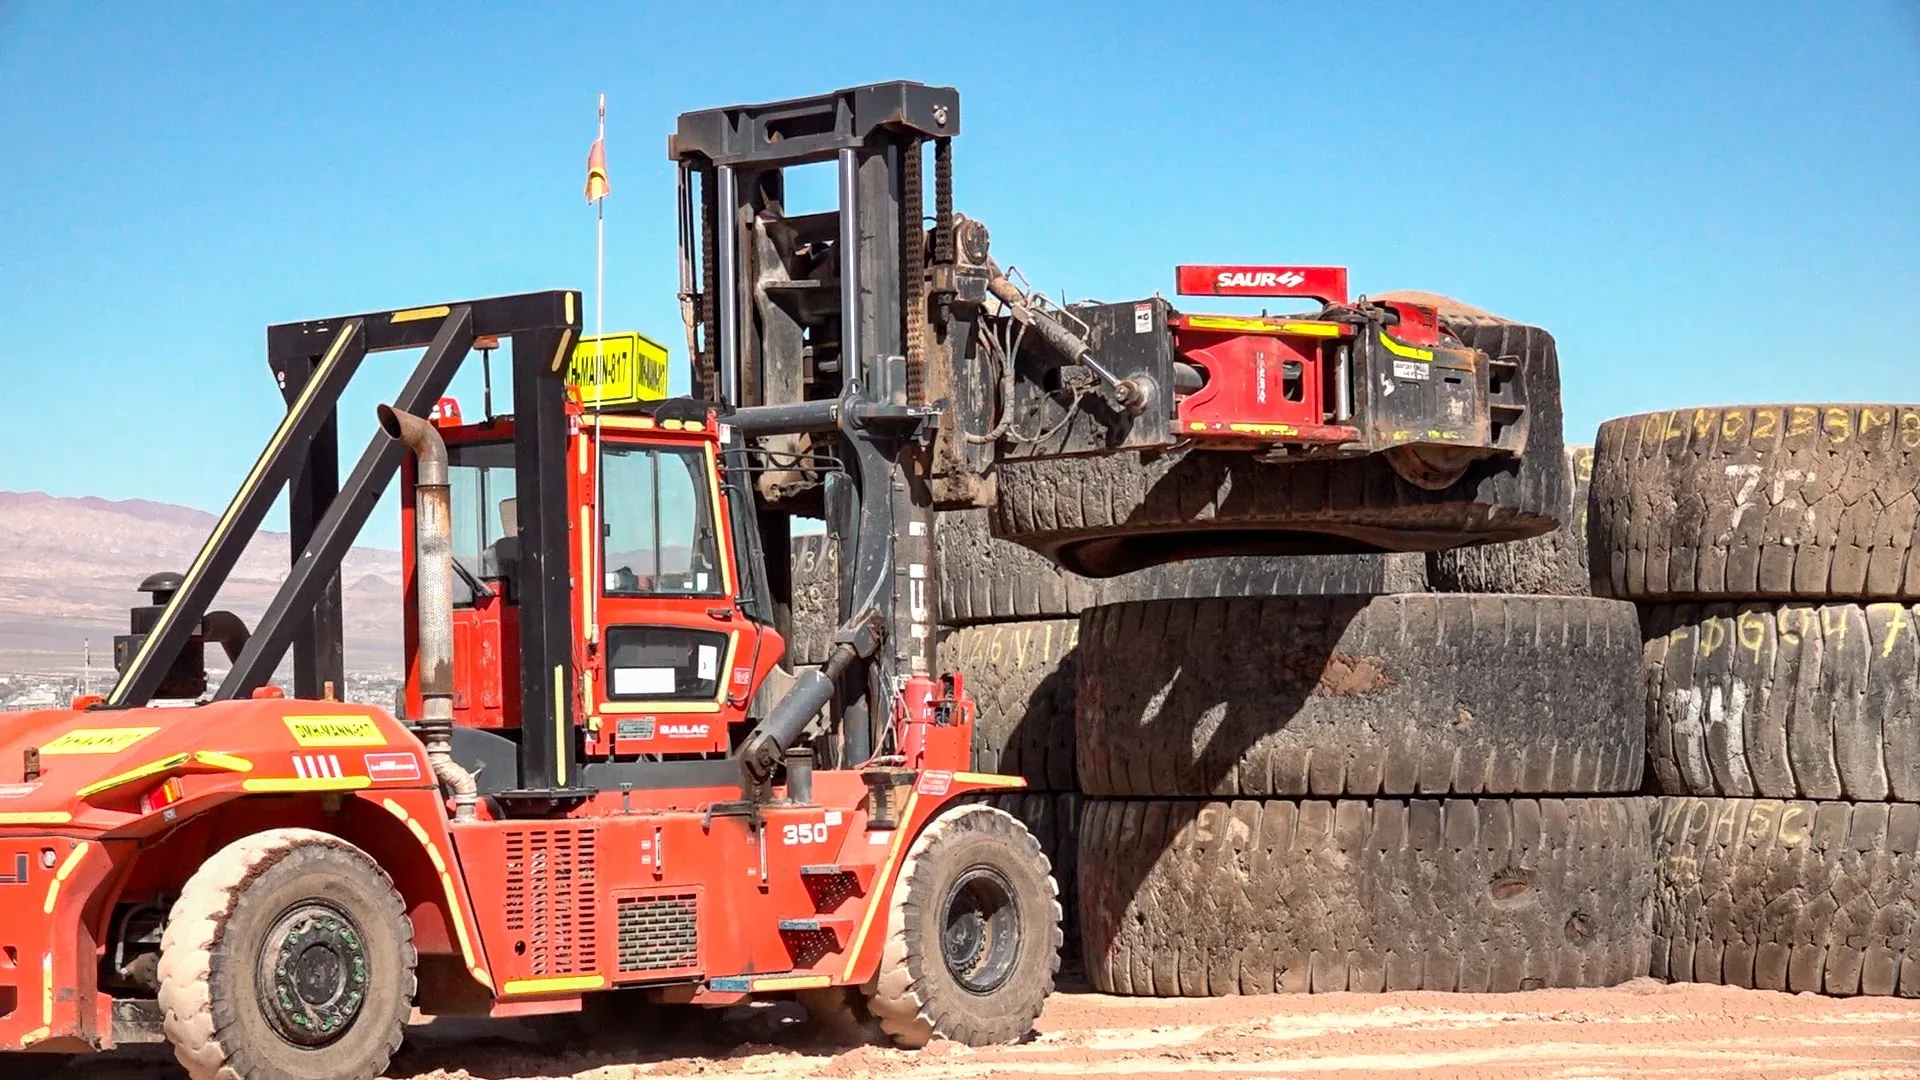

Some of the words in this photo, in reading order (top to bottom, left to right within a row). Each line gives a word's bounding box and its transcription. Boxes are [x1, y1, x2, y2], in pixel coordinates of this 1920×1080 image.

[1217, 272, 1277, 288] SAUR
[660, 724, 709, 735] BAILAC
[783, 822, 828, 846] 350
